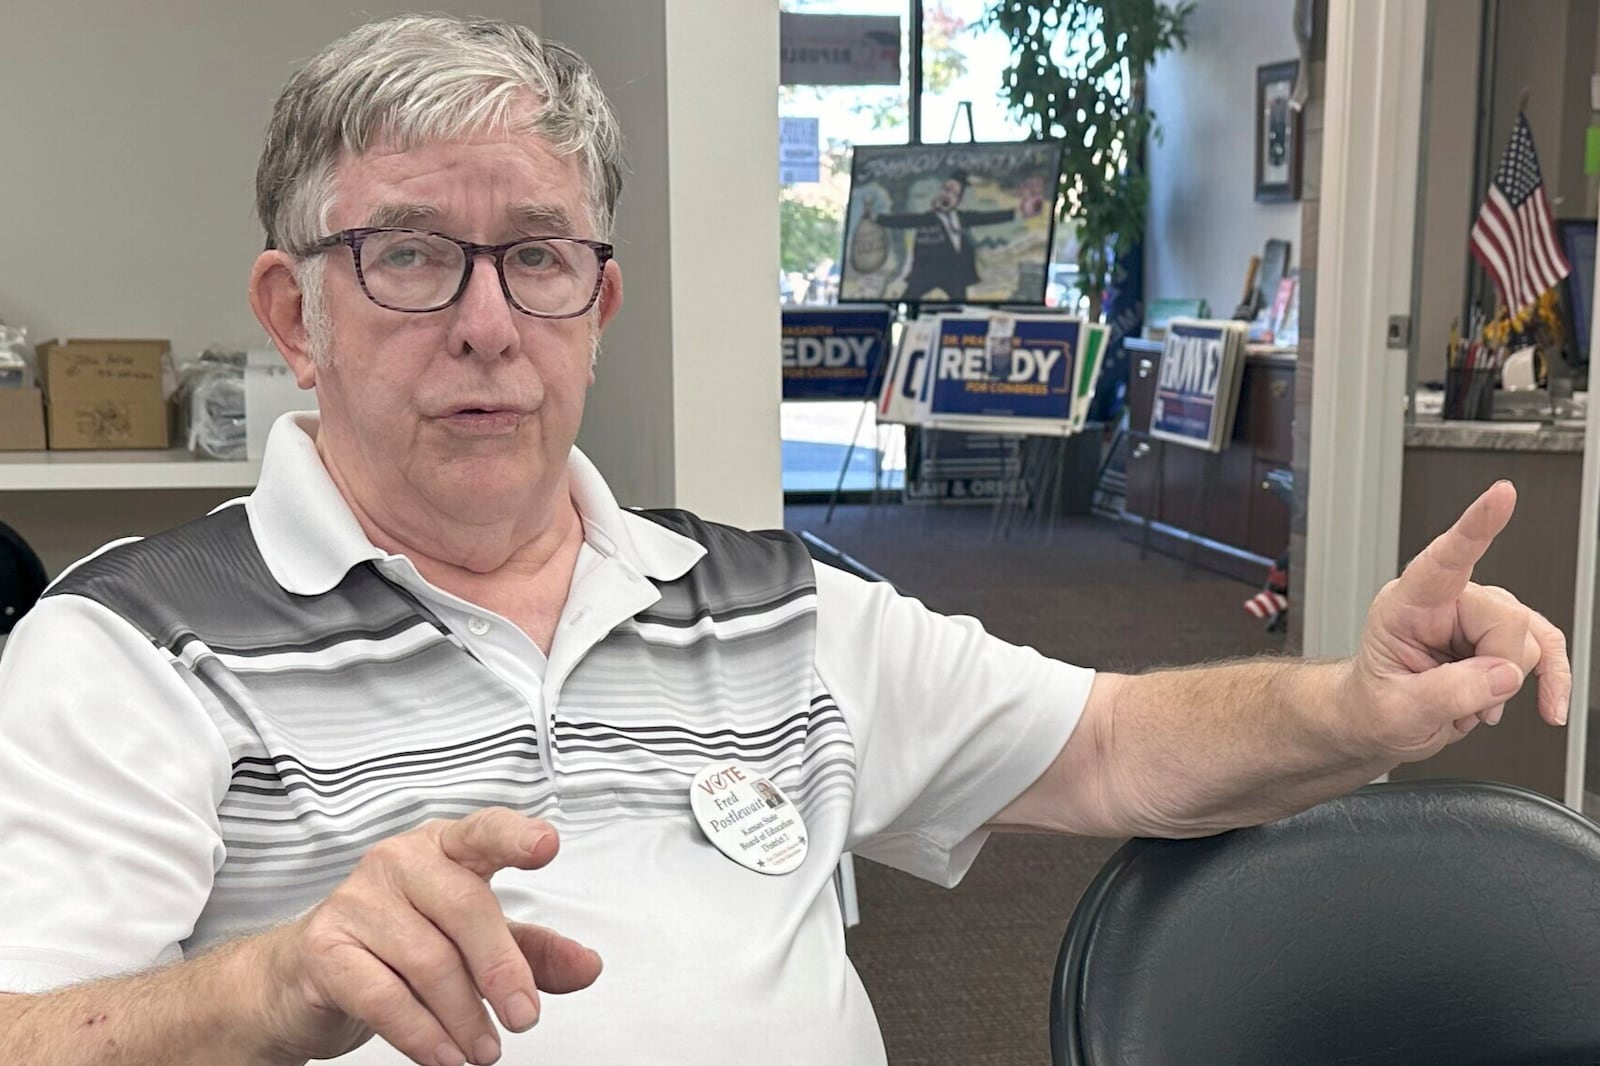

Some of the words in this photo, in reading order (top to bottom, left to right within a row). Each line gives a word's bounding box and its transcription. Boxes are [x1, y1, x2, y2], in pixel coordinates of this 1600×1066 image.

[782, 337, 876, 368] EDDY
[938, 347, 1061, 383] REDY
[966, 382, 987, 393] FOR
[989, 382, 1048, 396] CONGRESS
[698, 766, 746, 795] VOTE
[710, 798, 766, 833] Postlewait
[714, 791, 740, 811] Fred
[739, 834, 760, 851] Board
[758, 831, 767, 840] of
[765, 819, 794, 837] Education
[741, 822, 765, 837] Kansas
[761, 836, 785, 852] District
